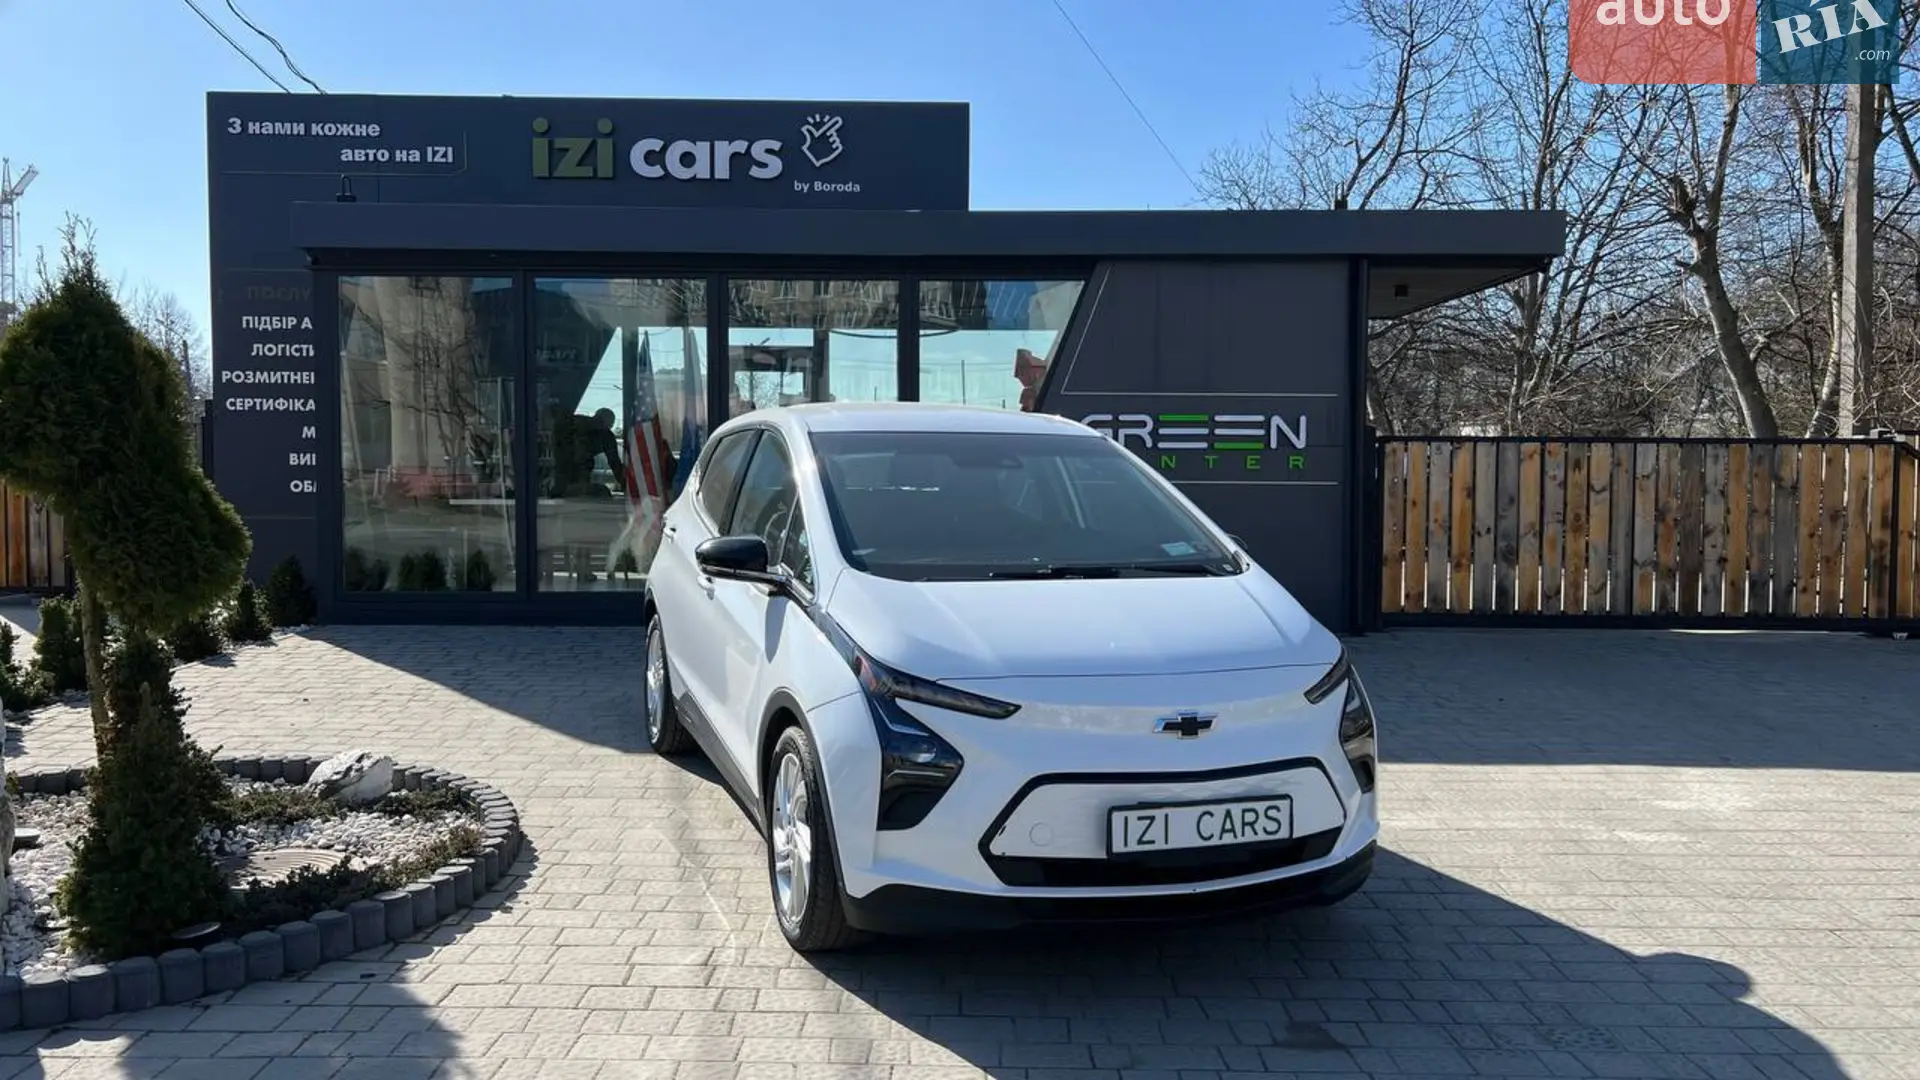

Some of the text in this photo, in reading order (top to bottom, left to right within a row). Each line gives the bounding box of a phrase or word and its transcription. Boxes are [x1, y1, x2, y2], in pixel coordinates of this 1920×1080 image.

[248, 120, 305, 136] нами
[311, 121, 381, 137] кожне
[340, 146, 454, 163] авто на IZI
[532, 116, 784, 180] izi cars
[794, 179, 861, 193] by Boroda
[242, 316, 298, 332] ПІДБІР
[225, 397, 316, 412] СЕРТИФІКА
[1160, 455, 1304, 470] NTER
[289, 479, 317, 493] ОБ
[1123, 804, 1282, 848] IZI CARS
